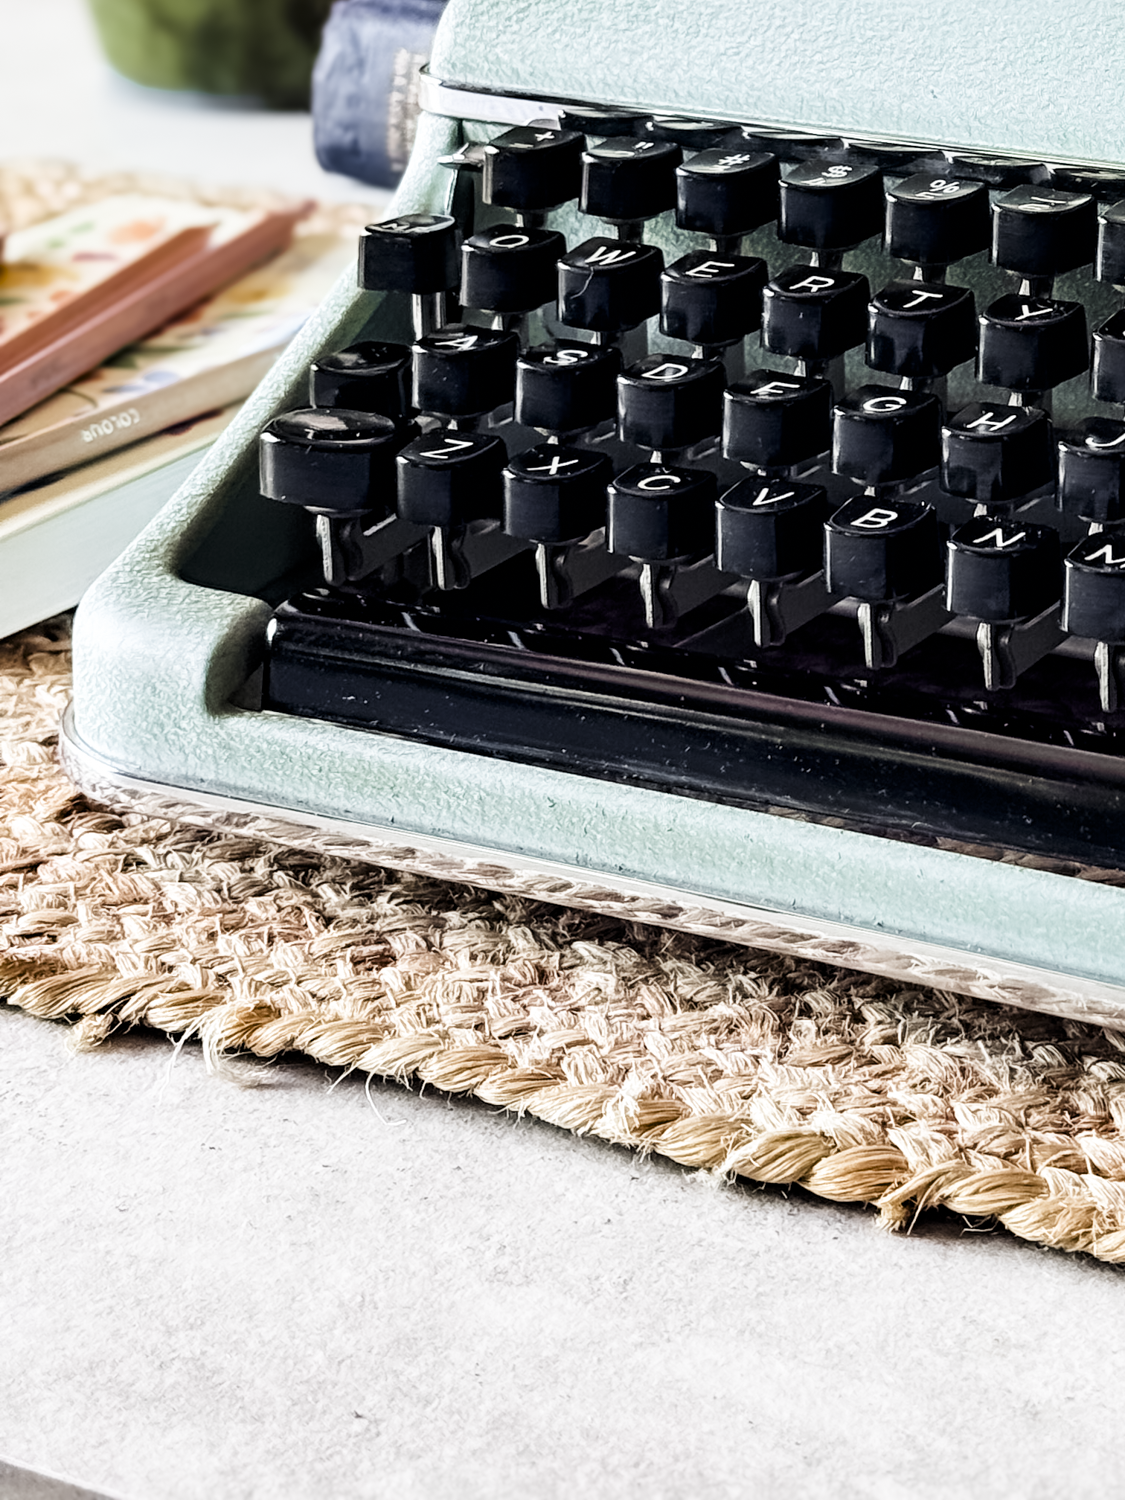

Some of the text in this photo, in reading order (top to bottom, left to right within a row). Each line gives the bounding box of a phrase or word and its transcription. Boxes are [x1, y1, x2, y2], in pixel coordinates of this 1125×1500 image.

[821, 165, 853, 178] $
[929, 179, 960, 194] %
[585, 246, 637, 266] W
[691, 260, 735, 277] E
[795, 276, 834, 292] R
[903, 290, 943, 307] T
[1015, 305, 1053, 320] Y
[435, 334, 478, 349] A
[543, 350, 588, 365] S
[643, 362, 688, 380] D
[751, 381, 799, 398] F
[863, 397, 906, 413] G
[967, 411, 1016, 431] H
[81, 407, 141, 443] COLOUR
[420, 438, 473, 458] Z
[527, 457, 578, 474] X
[637, 474, 680, 490] C
[753, 488, 794, 505] V
[853, 508, 897, 529] B
[973, 528, 1025, 547] N
